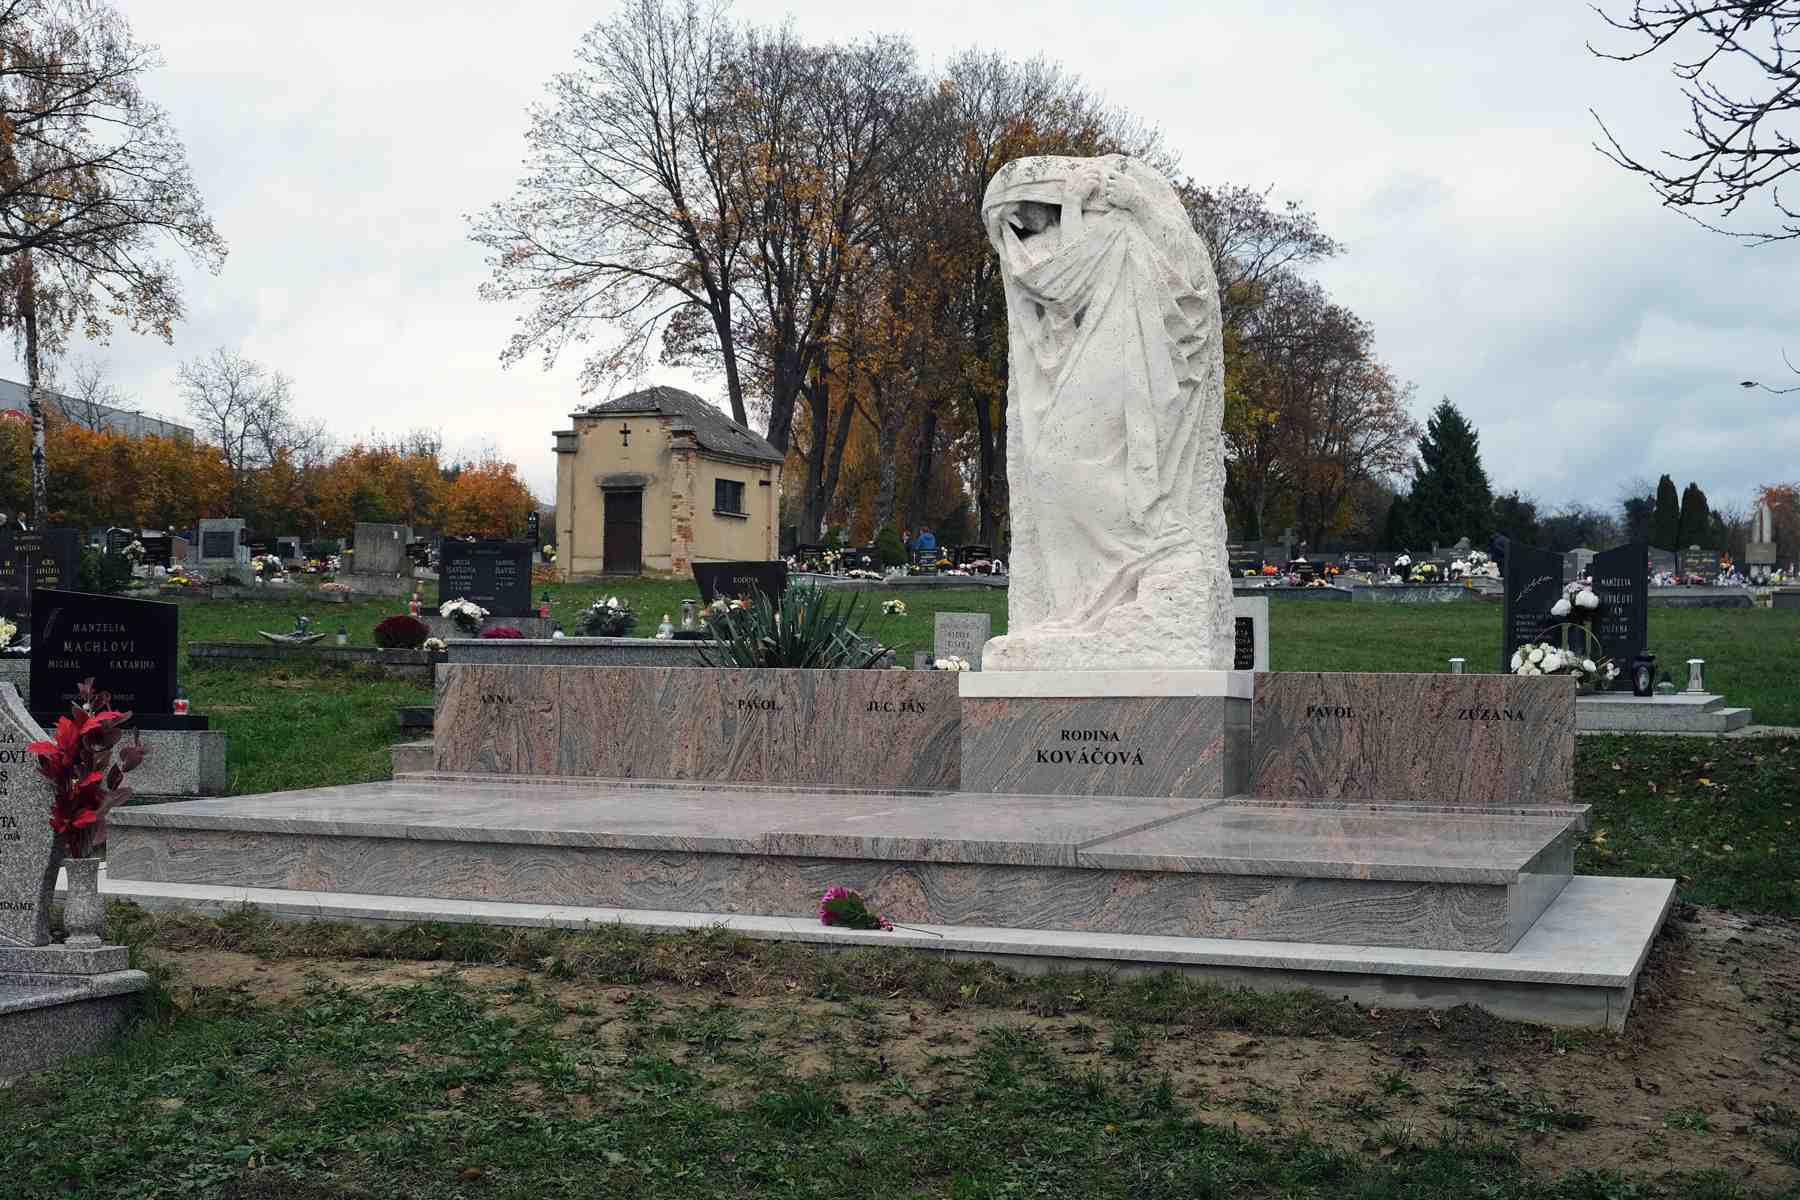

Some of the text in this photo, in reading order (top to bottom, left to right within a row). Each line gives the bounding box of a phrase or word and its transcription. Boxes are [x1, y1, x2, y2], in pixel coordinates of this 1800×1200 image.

[737, 700, 778, 711] PAVOL
[1306, 705, 1356, 718] PAVOL
[1457, 706, 1525, 721] ZUZANA
[1060, 729, 1121, 742] RODINA
[1036, 747, 1145, 766] KOVÁČOVÁ
